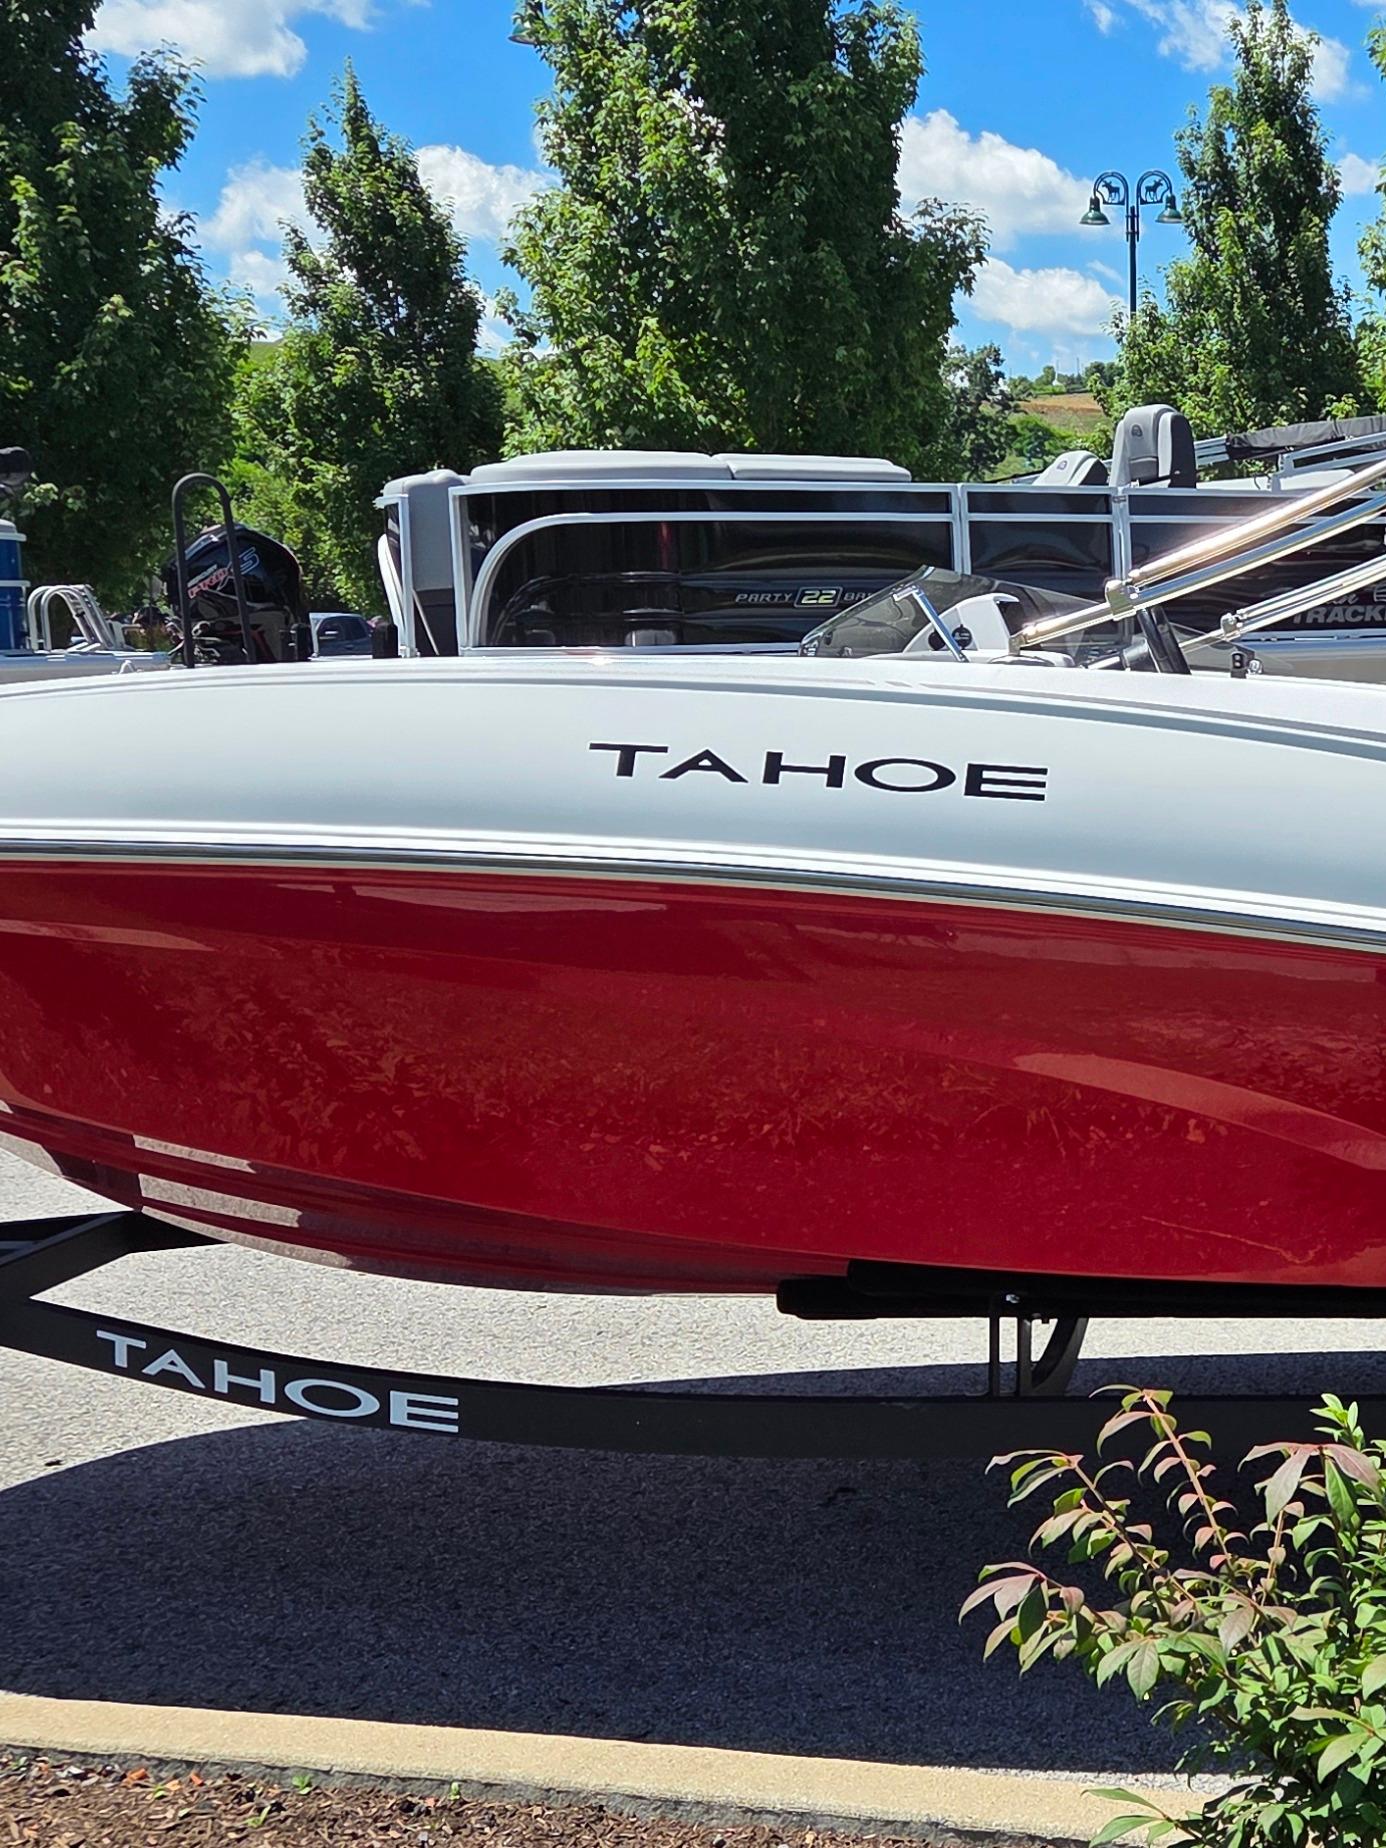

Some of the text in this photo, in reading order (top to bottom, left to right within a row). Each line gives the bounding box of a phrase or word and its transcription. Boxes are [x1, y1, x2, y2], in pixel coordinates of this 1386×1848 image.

[735, 593, 793, 602] PARTY
[801, 590, 837, 604] 22
[589, 743, 1048, 802] TAHOE
[96, 1330, 459, 1433] TAHOE
